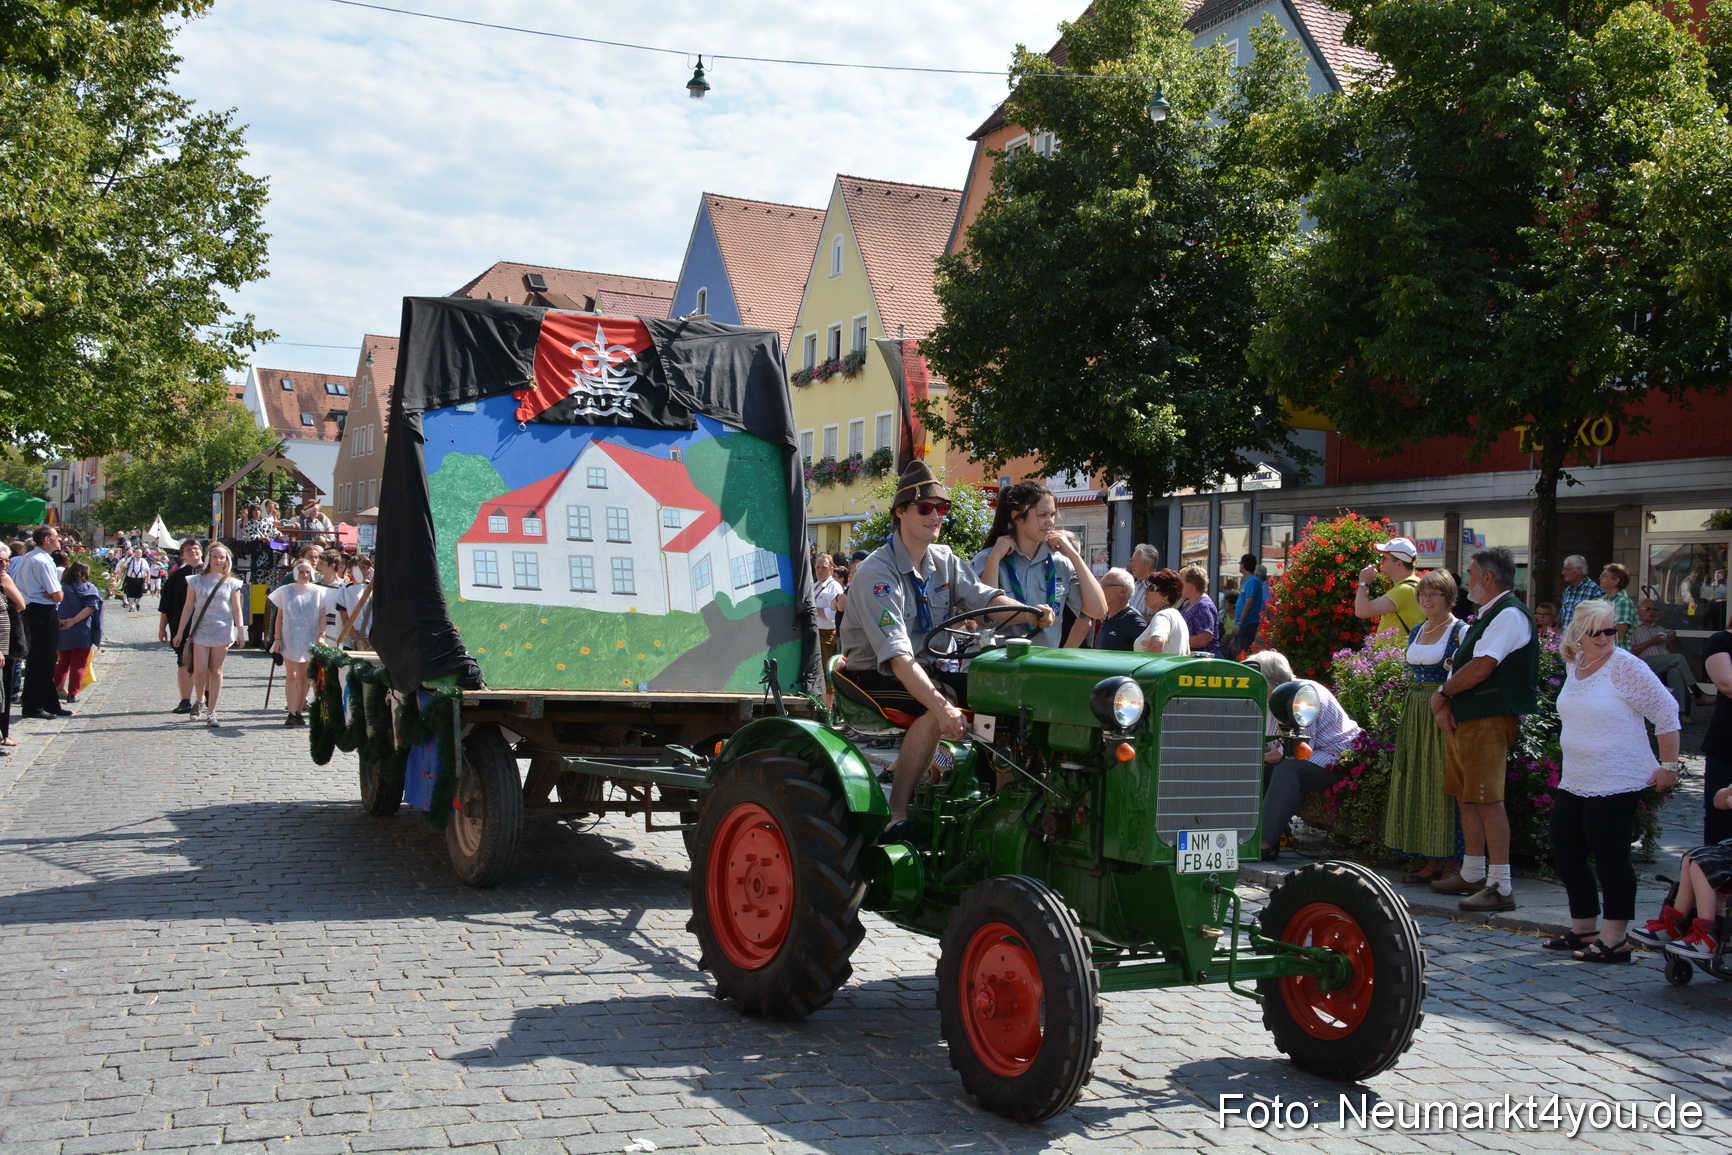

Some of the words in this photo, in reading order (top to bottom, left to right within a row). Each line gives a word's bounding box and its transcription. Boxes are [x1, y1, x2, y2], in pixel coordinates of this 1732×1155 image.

[1178, 674, 1250, 689] DEUTZ
[1191, 833, 1210, 851] NM
[1184, 853, 1202, 871] FB
[1205, 852, 1222, 870] 48
